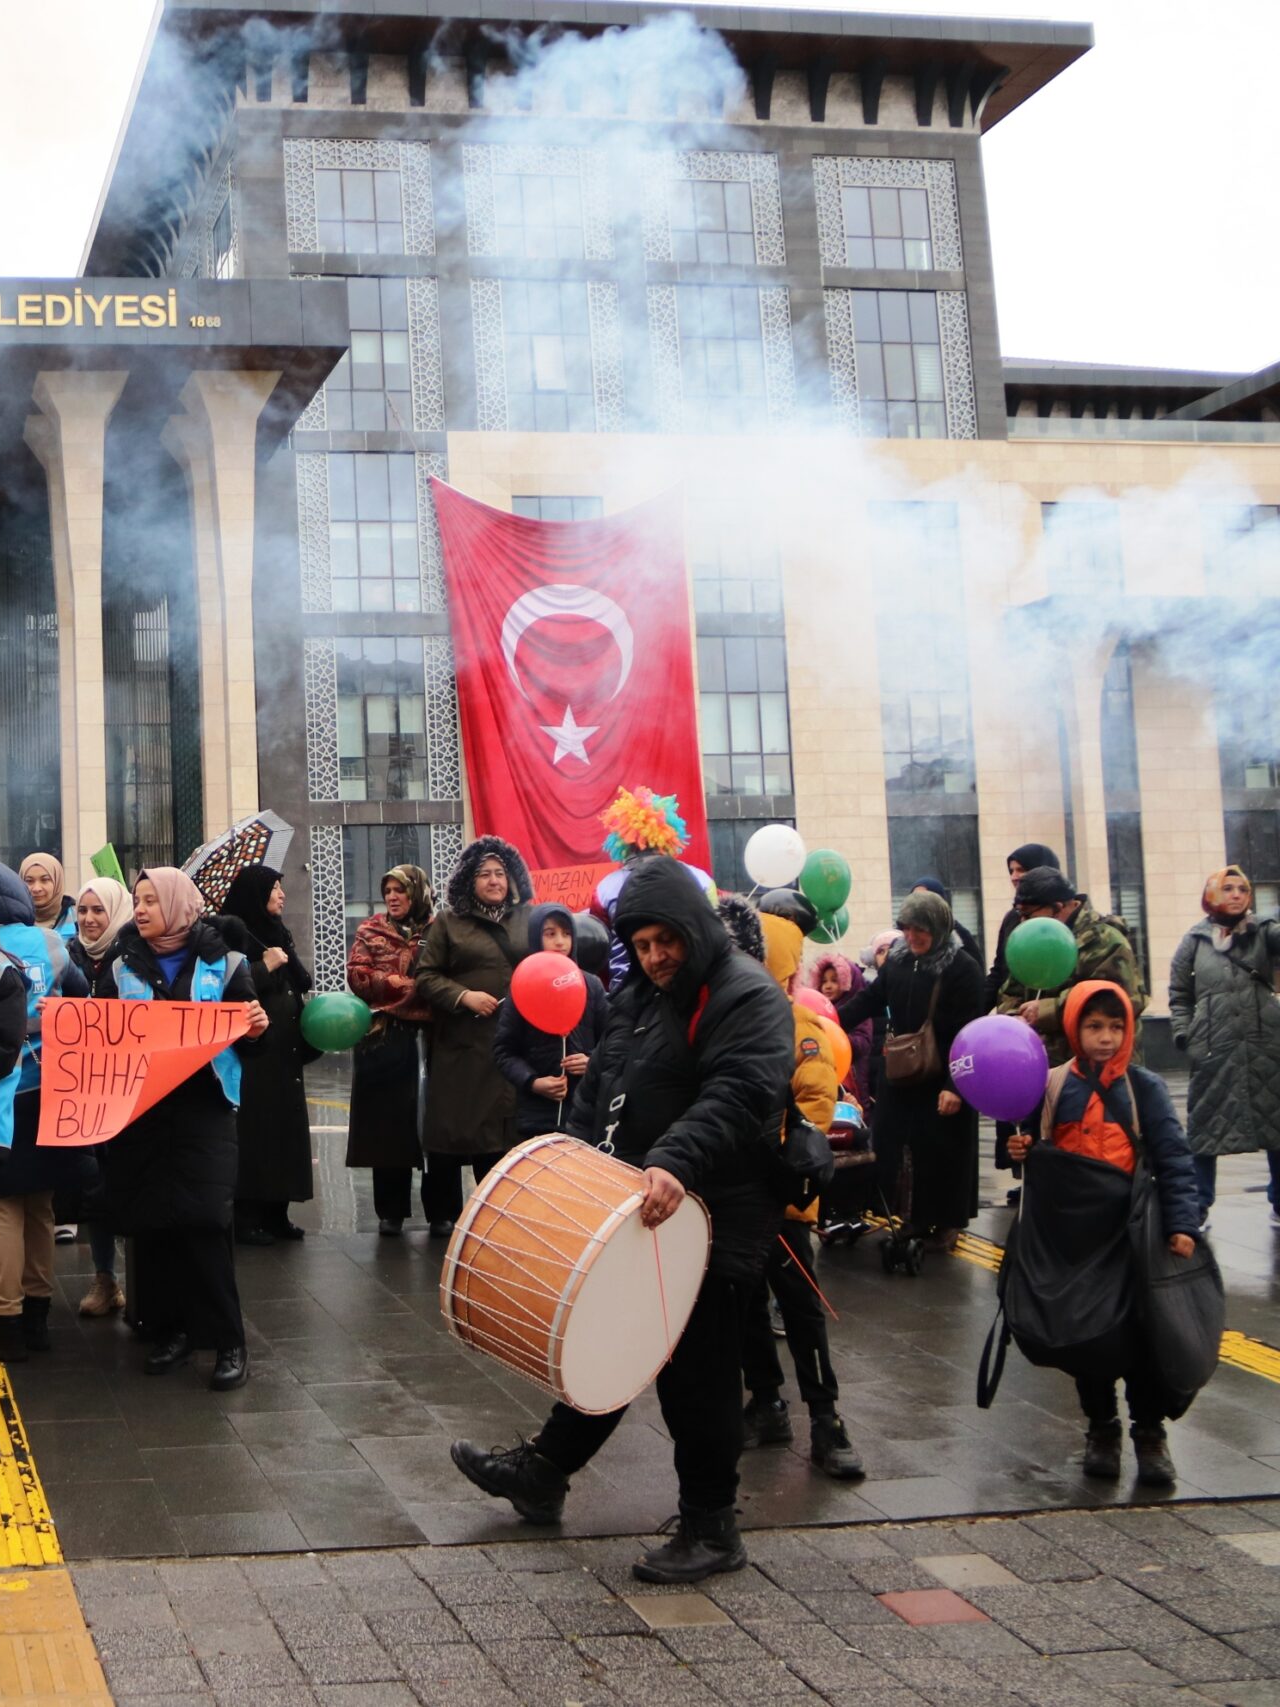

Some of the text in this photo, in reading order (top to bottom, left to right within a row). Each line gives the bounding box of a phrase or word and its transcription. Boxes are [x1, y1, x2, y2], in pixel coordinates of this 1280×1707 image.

[189, 315, 222, 328] 1868
[54, 1000, 242, 1048] ORUÇ TUT
[55, 1098, 116, 1139] BUL
